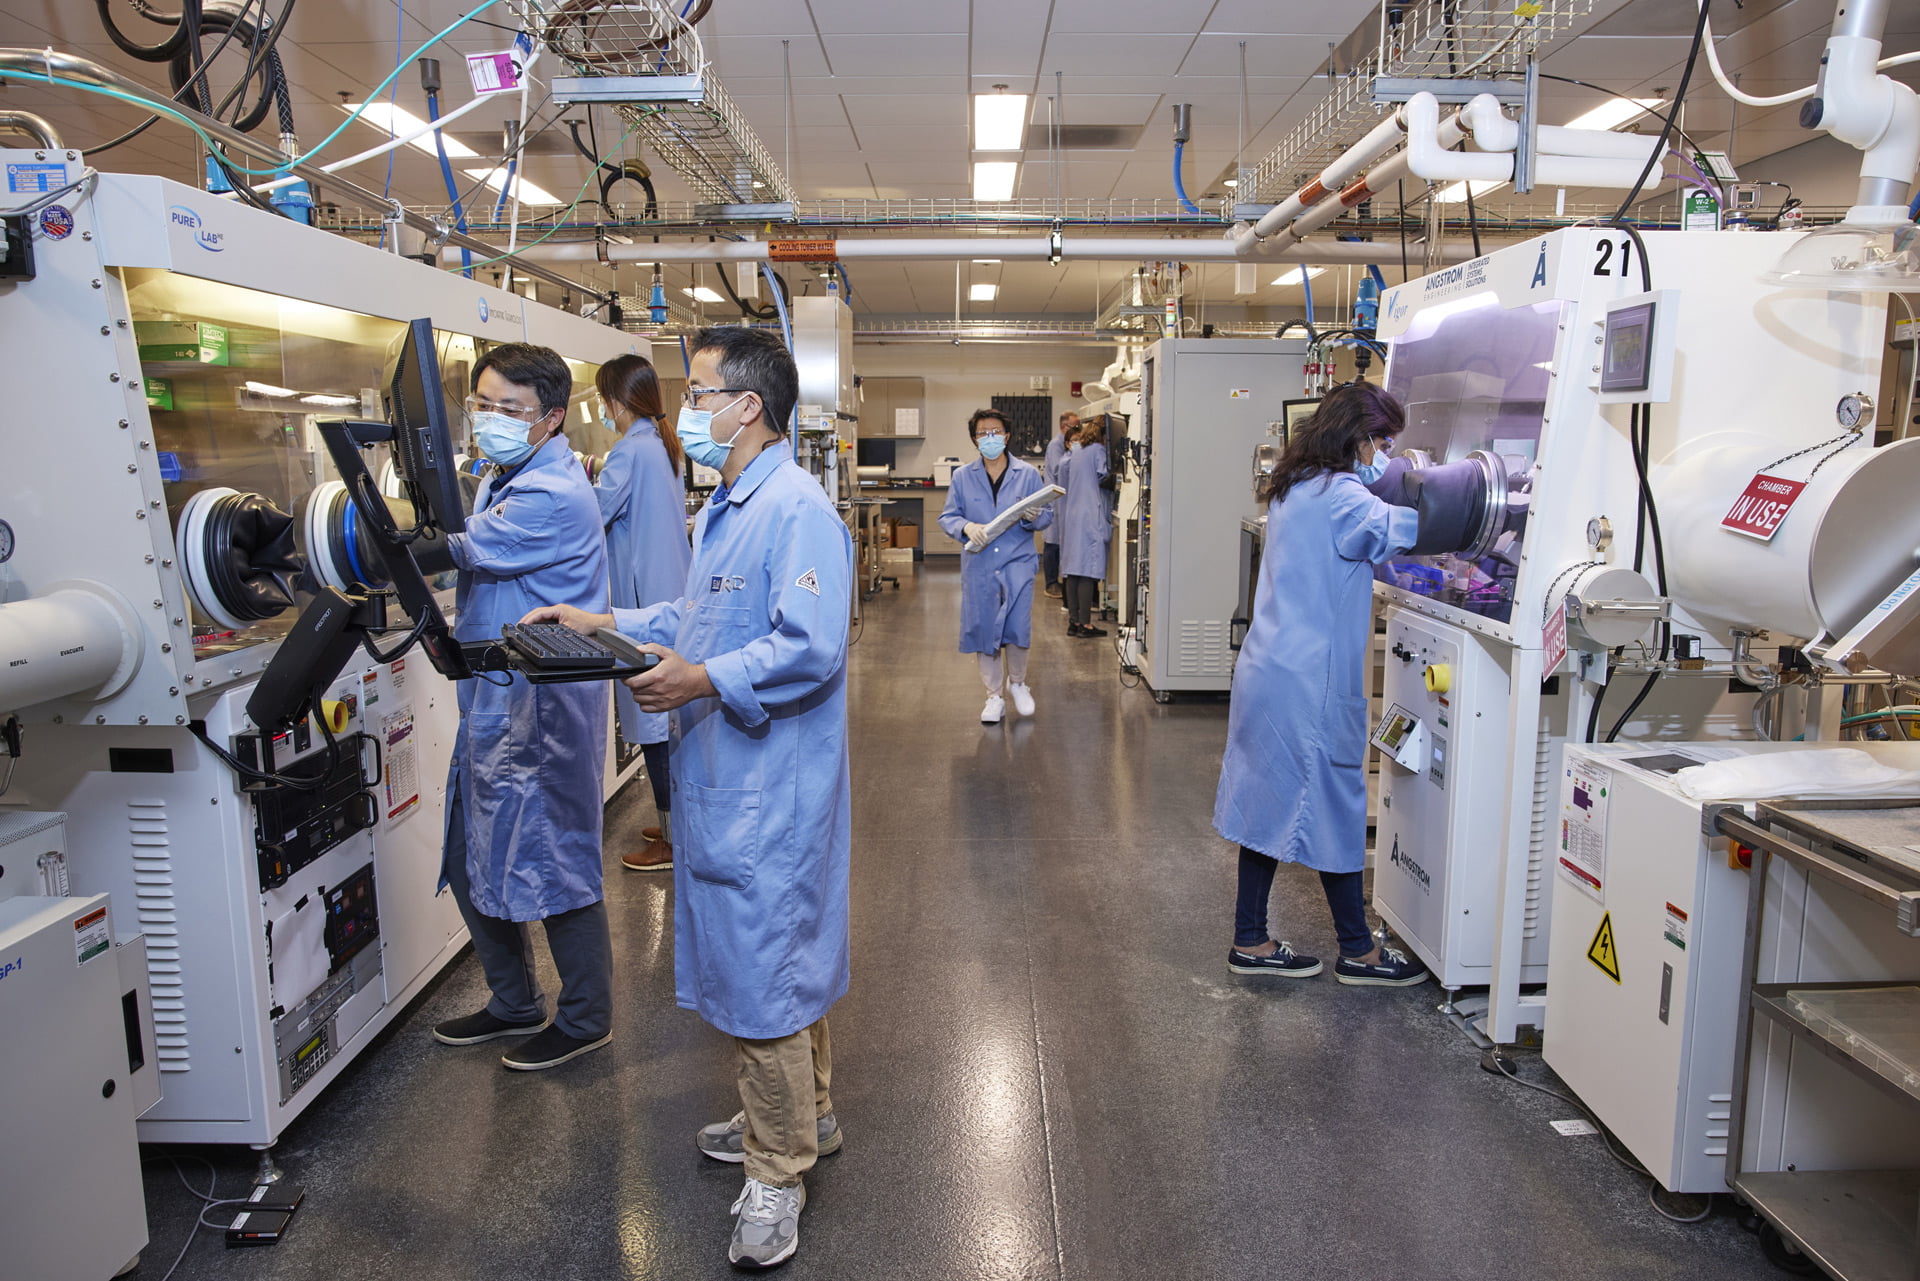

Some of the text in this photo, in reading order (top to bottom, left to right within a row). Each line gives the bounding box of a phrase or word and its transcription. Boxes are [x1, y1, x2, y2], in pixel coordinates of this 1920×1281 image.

[171, 212, 195, 228] PURE
[201, 230, 217, 244] LAB
[779, 243, 799, 251] COOLING
[800, 243, 816, 251] TOWER
[1467, 256, 1490, 271] INTEGRATED
[1593, 238, 1631, 277] 21
[1425, 266, 1463, 292] ANGSTROM
[1465, 274, 1487, 289] SOLUTIONS
[1466, 267, 1483, 280] SYSTEMS
[1423, 284, 1462, 302] ENGINEERING
[1387, 290, 1409, 321] Vigor
[1757, 480, 1793, 496] CHAMBER
[1727, 494, 1789, 530] IN USE
[1878, 598, 1898, 610] Do
[1891, 583, 1916, 598] Not
[60, 646, 84, 656] EVACUATE
[1551, 625, 1564, 662] USE
[9, 658, 28, 667] REFILL
[1400, 850, 1430, 888] ANGSTROM
